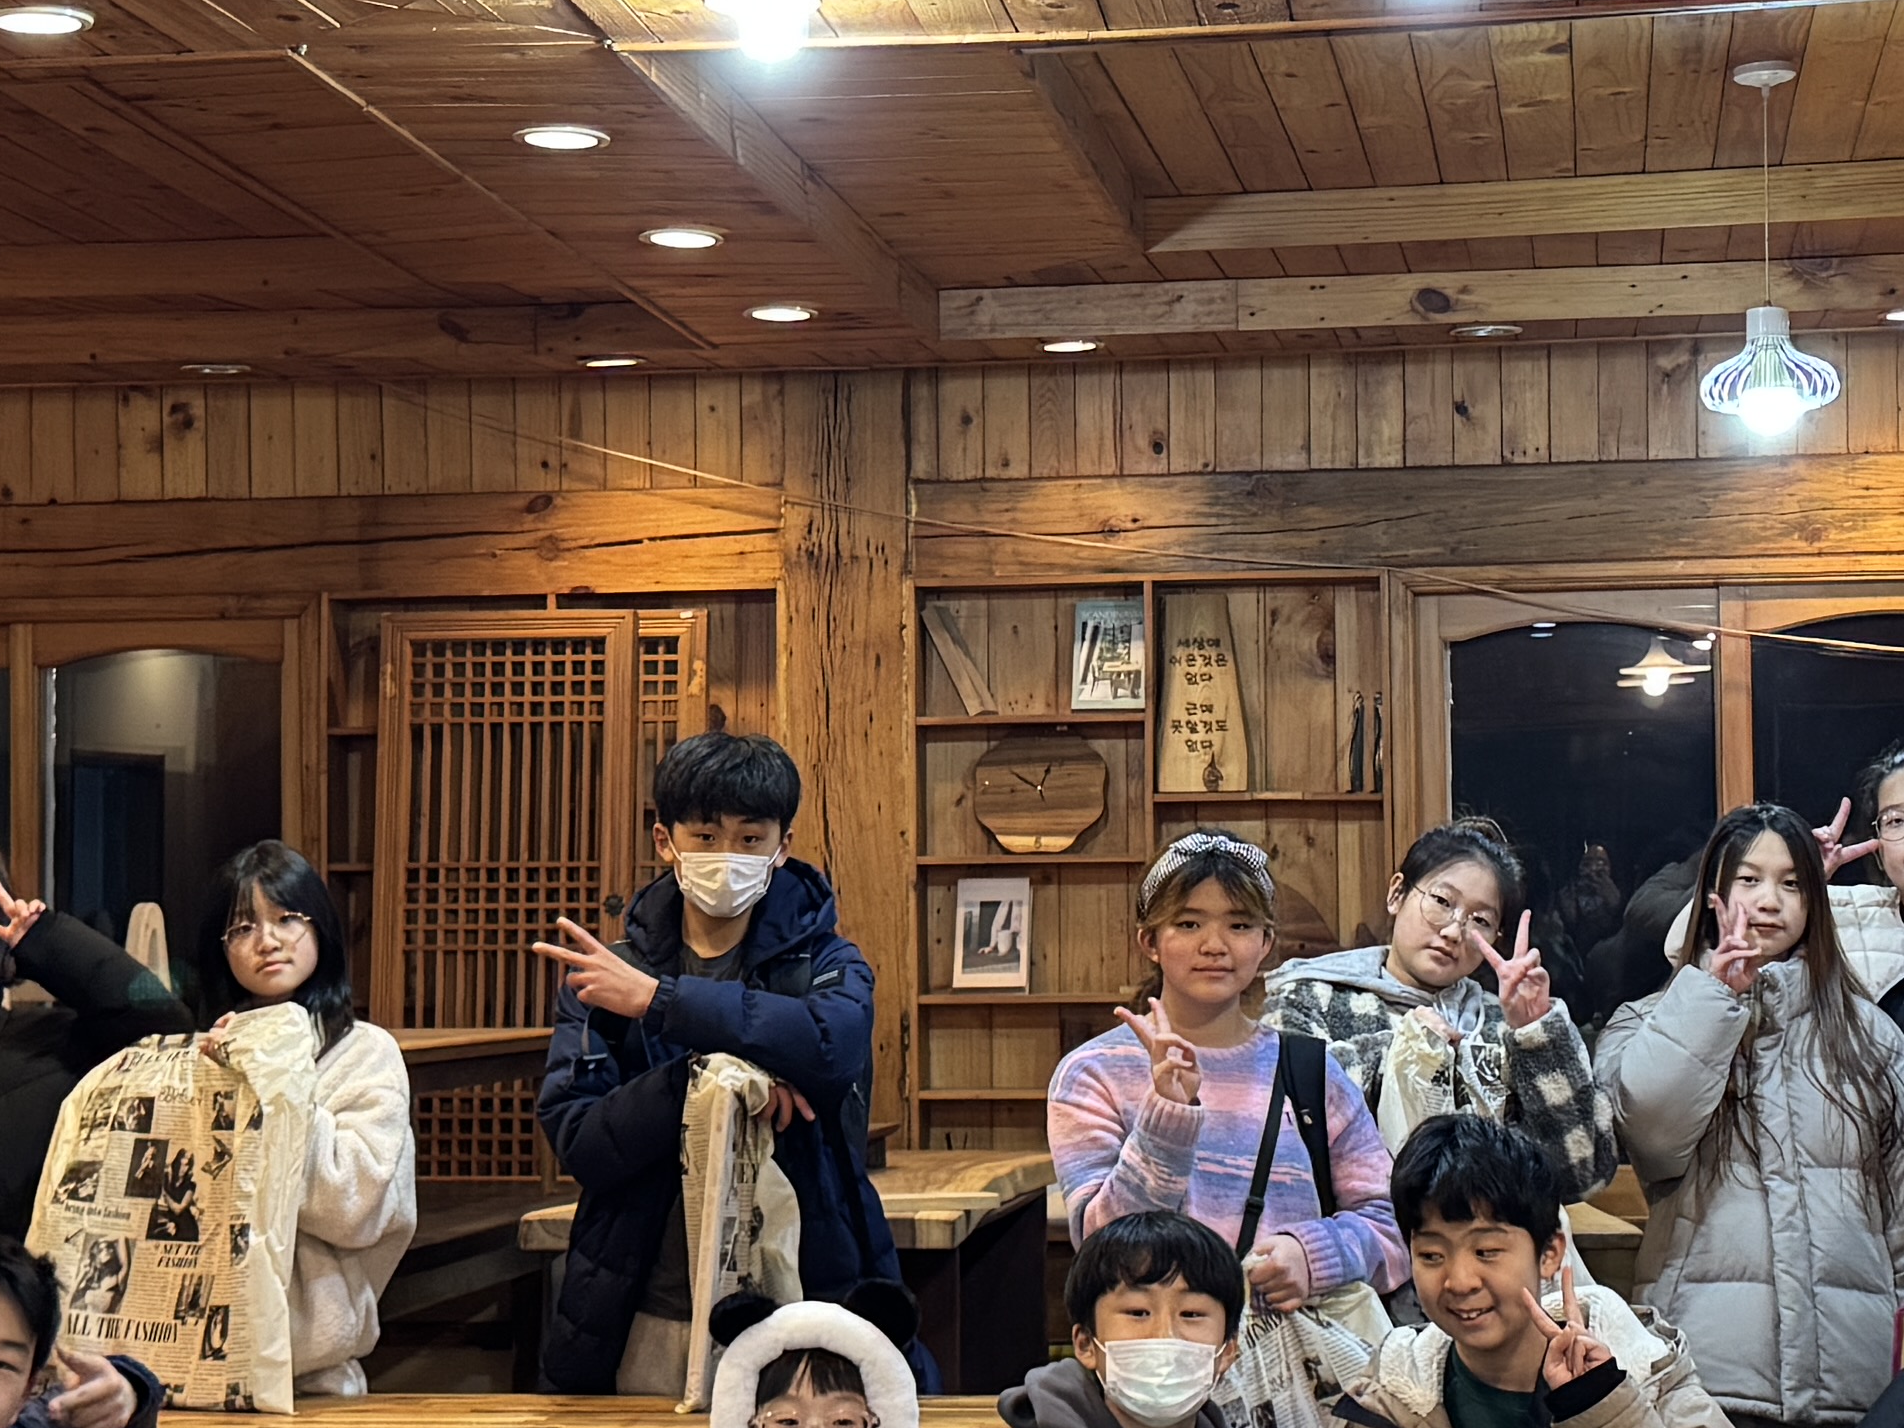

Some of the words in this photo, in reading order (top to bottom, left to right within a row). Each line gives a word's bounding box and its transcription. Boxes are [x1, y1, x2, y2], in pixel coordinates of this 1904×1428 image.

[1177, 637, 1221, 651] 세상에
[1184, 672, 1214, 686] 없다
[1184, 739, 1214, 753] 없다
[65, 1313, 92, 1336] ALL
[96, 1316, 123, 1340] THE
[123, 1319, 178, 1343] FASHION
